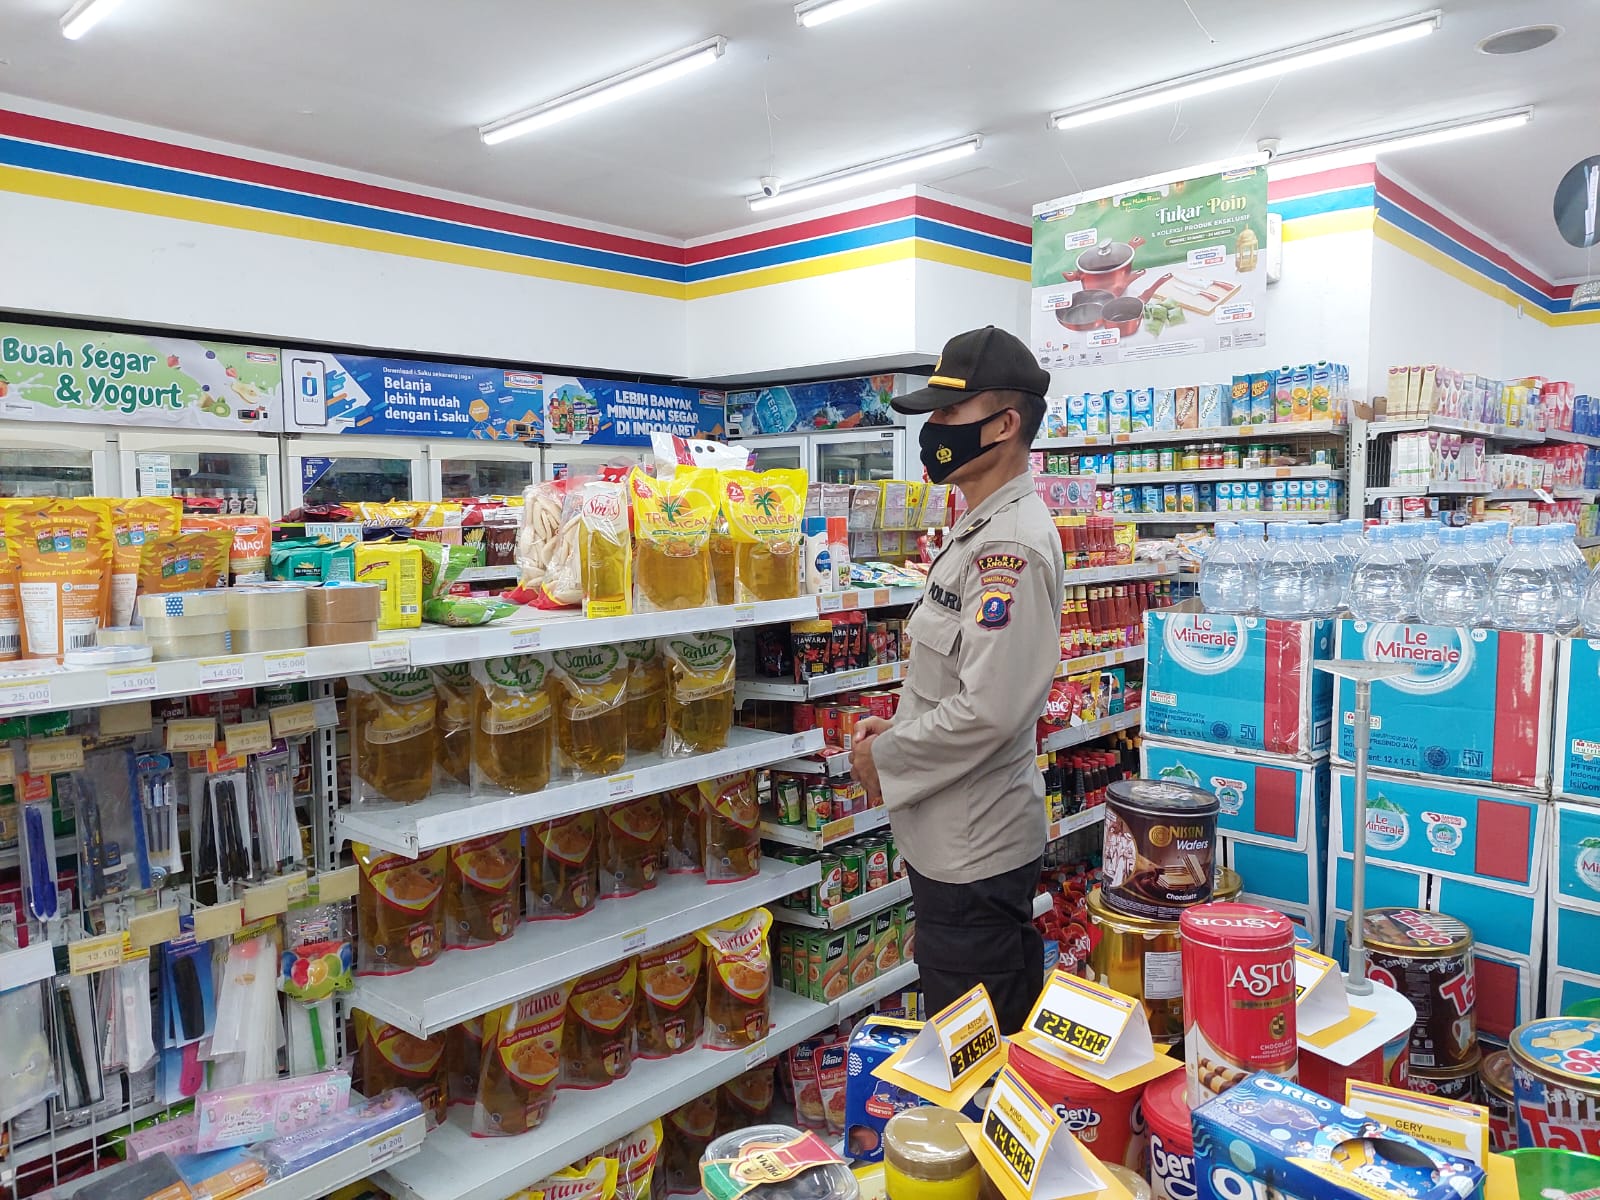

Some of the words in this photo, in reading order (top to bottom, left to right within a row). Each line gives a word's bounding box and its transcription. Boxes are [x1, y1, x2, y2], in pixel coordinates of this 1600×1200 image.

[1156, 205, 1203, 224] Tukar
[1207, 195, 1247, 214] Poin
[1184, 222, 1212, 231] PRODUK
[2, 338, 73, 366] Buah
[82, 343, 156, 378] Segar
[384, 376, 432, 394] Belanja
[57, 375, 80, 401] &
[88, 377, 182, 413] Yogurt
[385, 391, 416, 406] lebih
[420, 395, 460, 408] mudah
[615, 390, 648, 405] LEBIH
[650, 395, 692, 411] BANYAK
[385, 407, 431, 424] dengan
[434, 410, 469, 423] i.saku
[606, 403, 666, 421] MINUMAN
[668, 410, 699, 424] SEGAR
[616, 422, 630, 434] DI
[633, 422, 696, 438] INDOMARET
[979, 556, 1022, 566] POLRES
[1194, 615, 1212, 631] Le
[1174, 628, 1236, 647] Minerale
[1405, 628, 1427, 645] Le
[683, 643, 718, 658] Sania
[1376, 641, 1459, 663] Minerale
[565, 651, 604, 668] Sania
[1045, 701, 1069, 713] ABC
[1384, 755, 1392, 763] 12
[1376, 814, 1387, 825] Le
[1169, 825, 1203, 838] NISSIN
[1177, 839, 1208, 851] Wafers
[1166, 892, 1197, 901] Chocolate
[1194, 917, 1284, 930] ASTOR
[1391, 910, 1453, 946] Tango
[518, 991, 560, 1021] ortune
[1043, 1014, 1111, 1055] 23.900
[956, 1028, 996, 1072] 31.500
[1255, 1078, 1332, 1111] OREO
[1053, 1103, 1093, 1122] Gery
[1395, 1120, 1423, 1132] GERY
[1078, 1130, 1098, 1143] Roll
[994, 1124, 1033, 1182] 14.900
